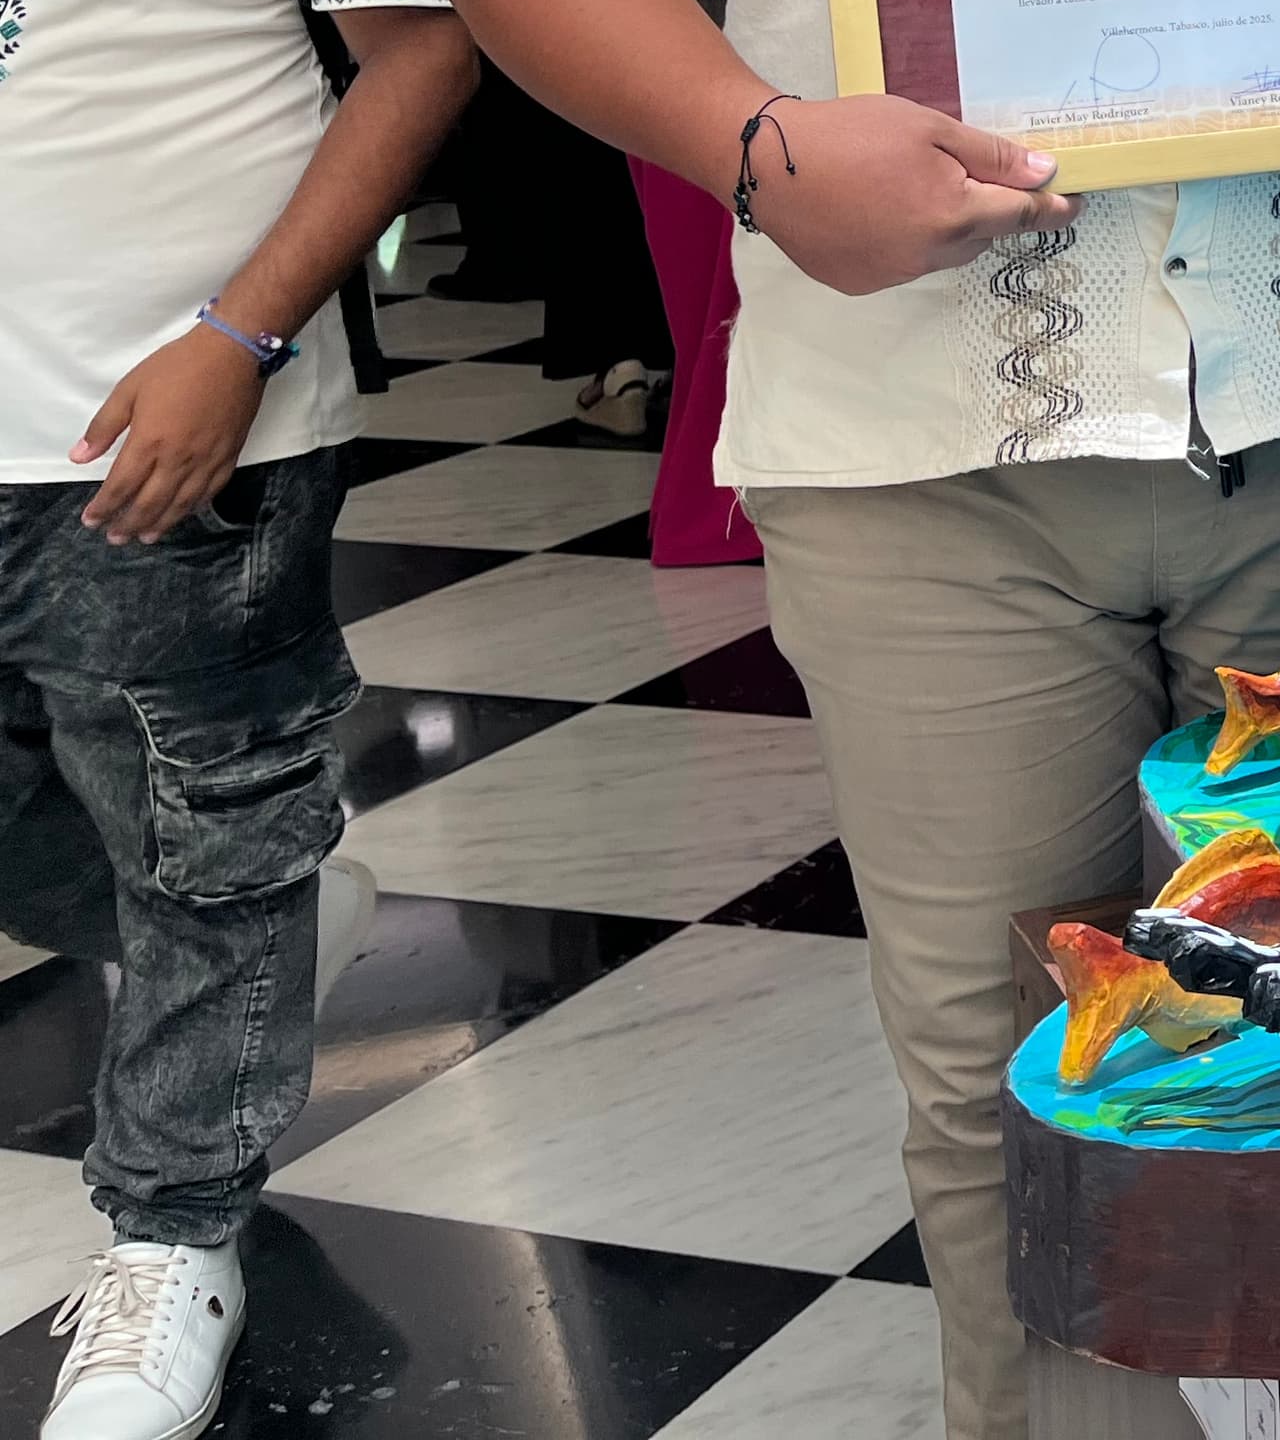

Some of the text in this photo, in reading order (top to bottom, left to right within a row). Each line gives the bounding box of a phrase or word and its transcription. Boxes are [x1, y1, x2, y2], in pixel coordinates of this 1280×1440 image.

[1212, 17, 1233, 30] julio
[1236, 16, 1247, 25] de
[1230, 93, 1268, 107] Vianey
[1030, 114, 1061, 128] Javier
[1065, 112, 1090, 124] May
